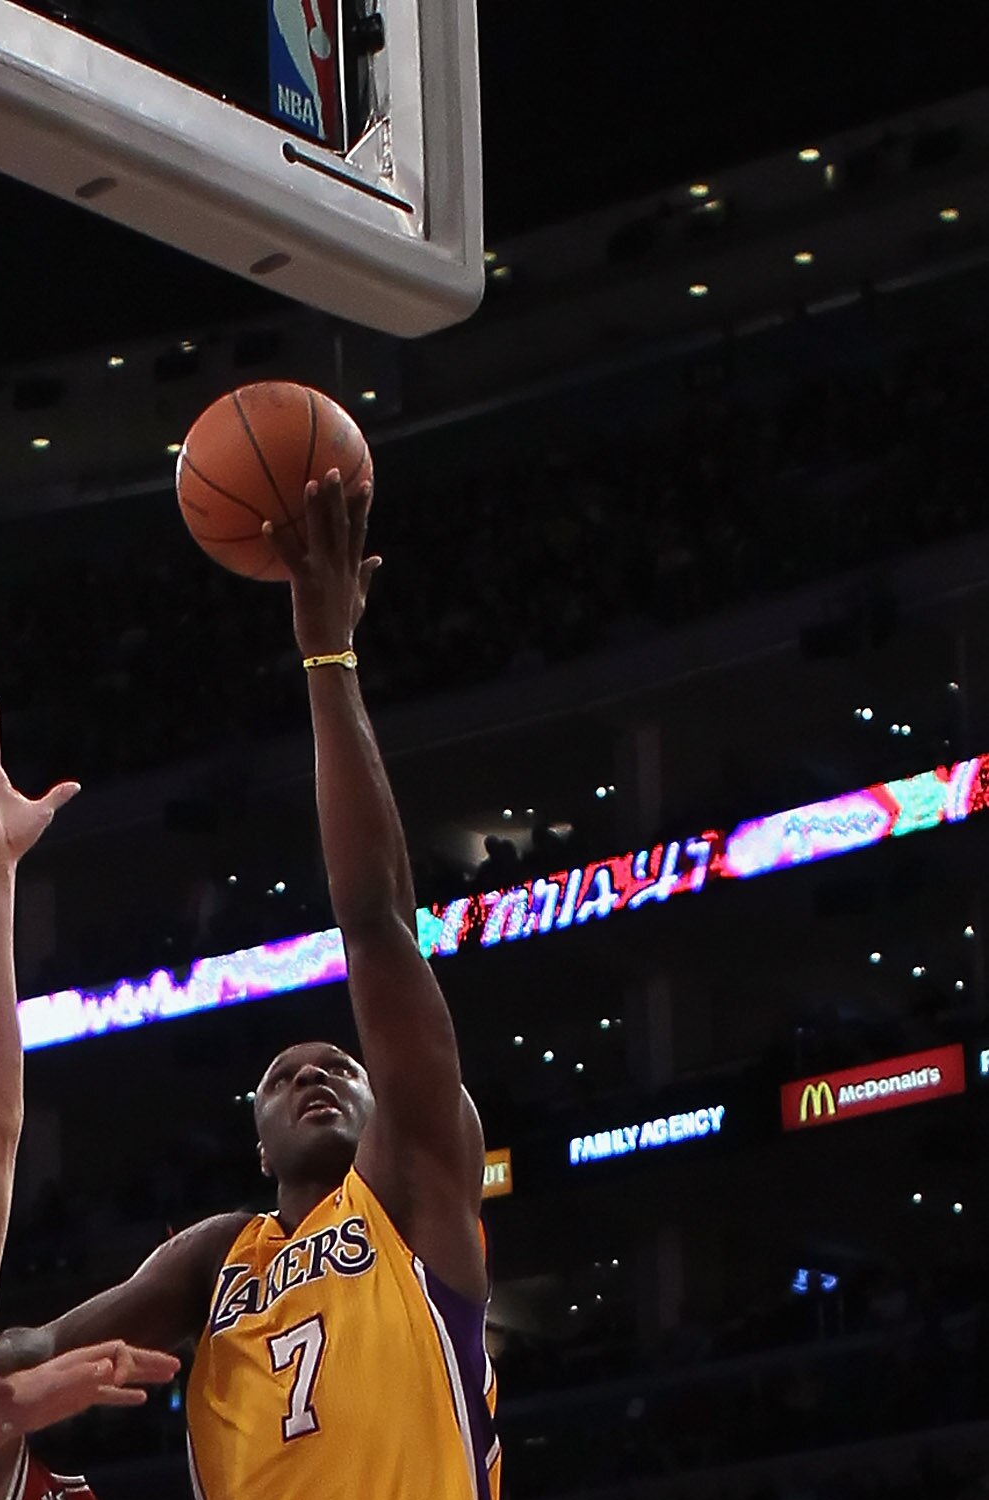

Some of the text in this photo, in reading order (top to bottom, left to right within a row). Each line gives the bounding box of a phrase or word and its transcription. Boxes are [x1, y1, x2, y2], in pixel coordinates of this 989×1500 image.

[277, 83, 315, 126] NBA
[838, 1065, 942, 1104] McDonald's
[639, 1104, 726, 1148] AGENCY
[209, 1216, 377, 1338] LAKERS
[266, 1313, 328, 1443] 7
